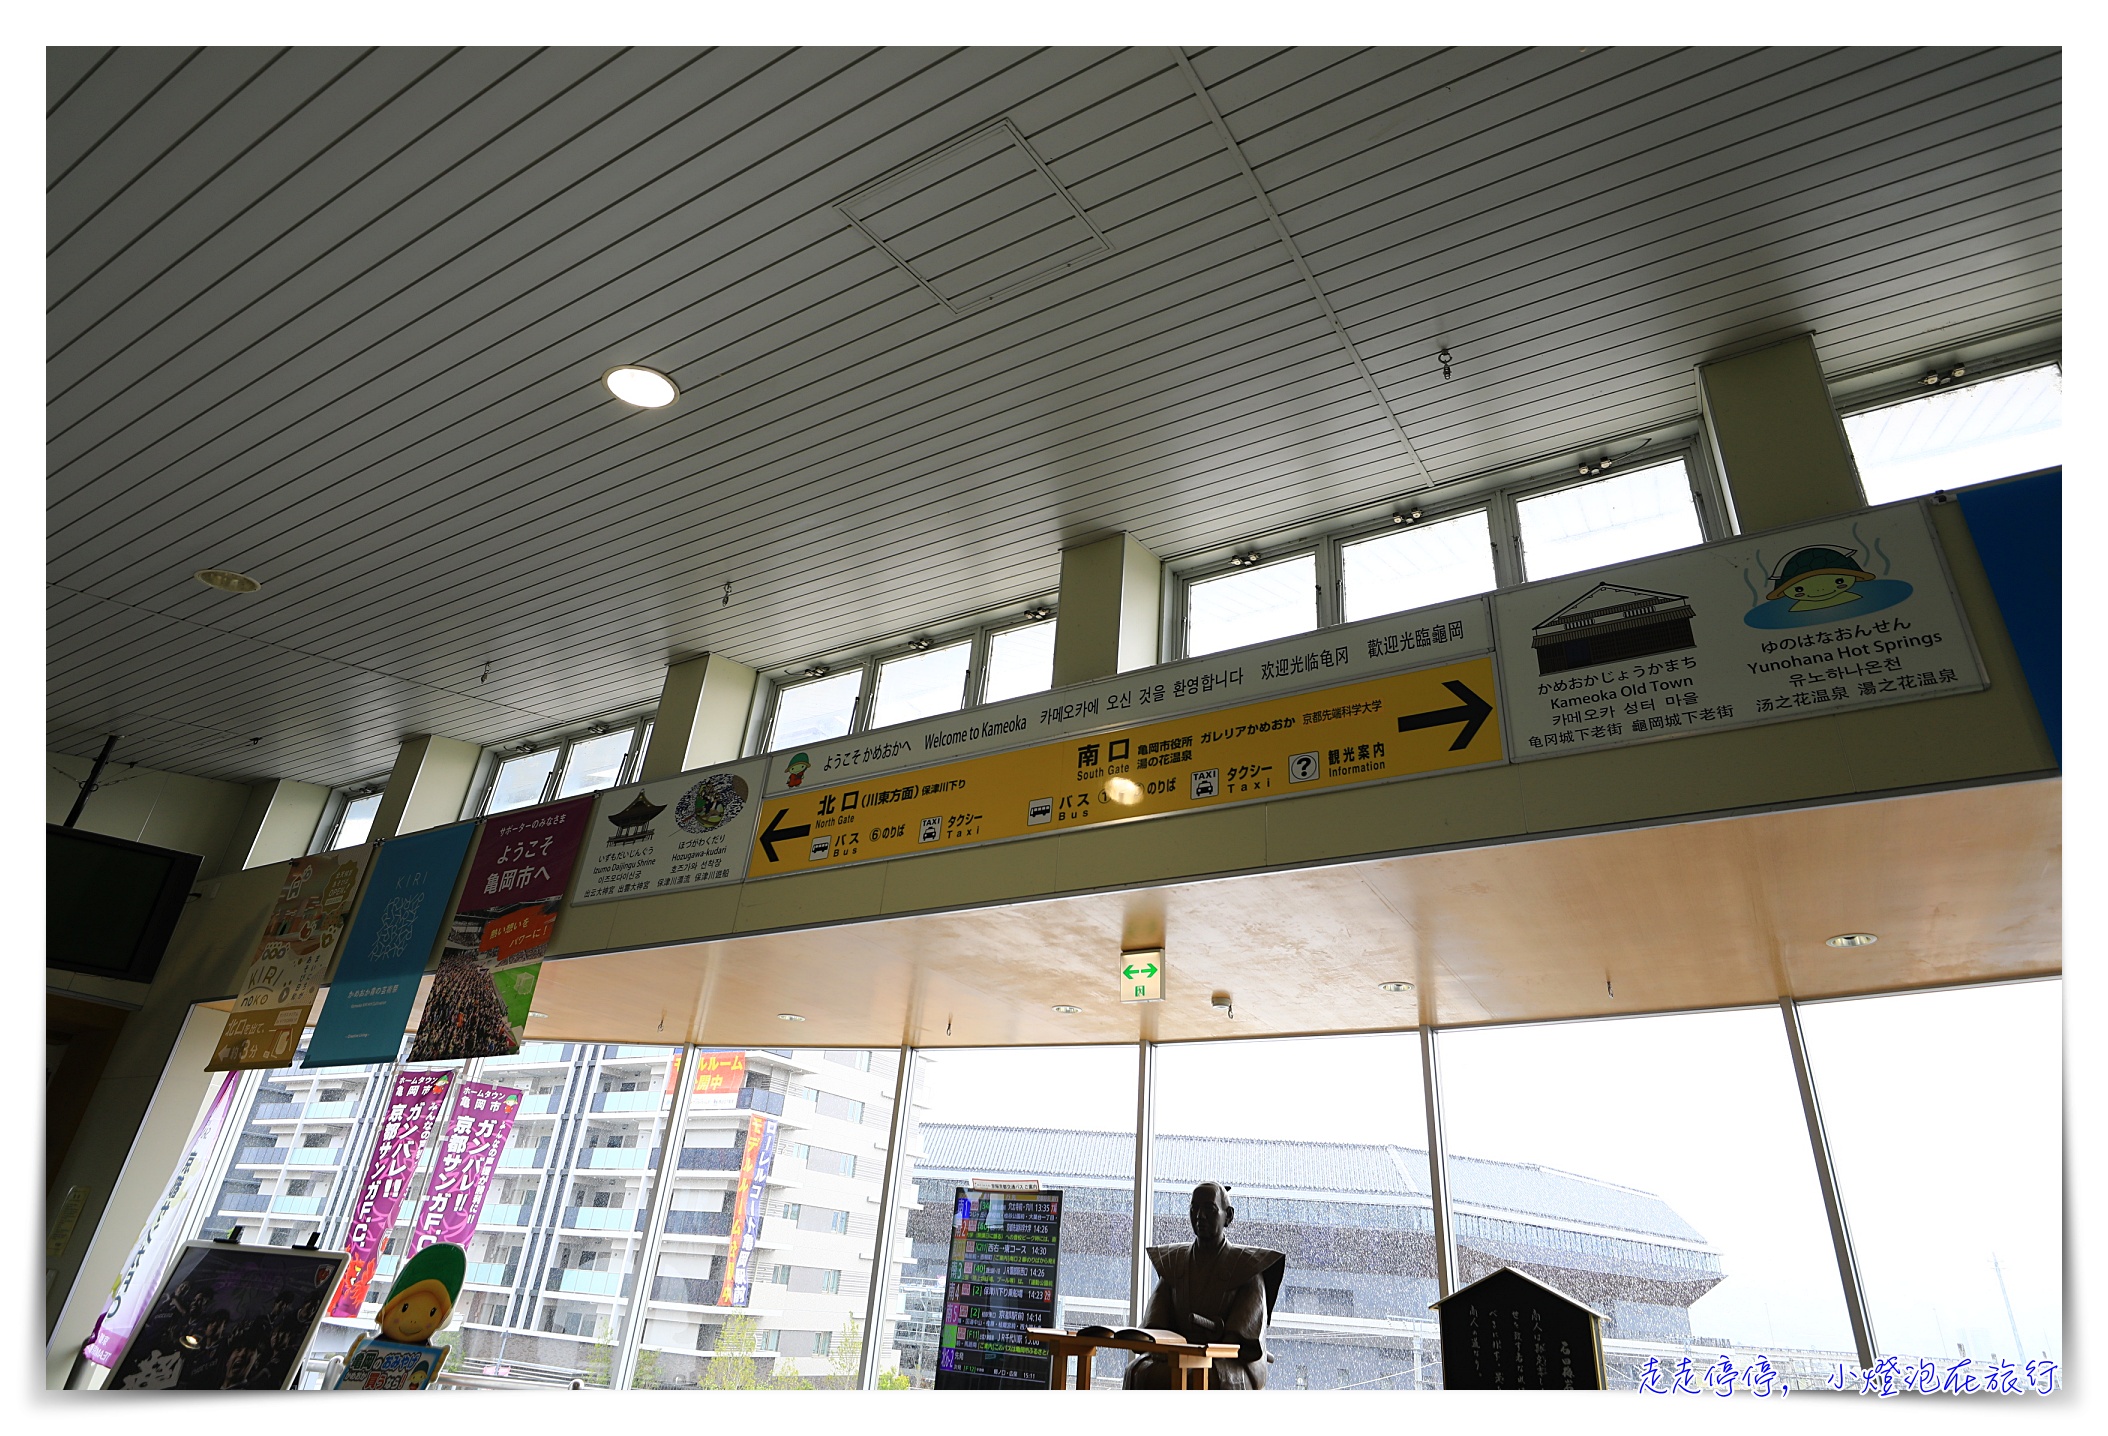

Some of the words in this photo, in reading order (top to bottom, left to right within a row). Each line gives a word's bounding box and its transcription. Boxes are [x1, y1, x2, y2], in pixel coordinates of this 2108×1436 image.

[1367, 620, 1464, 659] 歡迎光臨龜岡
[1761, 617, 1912, 654] ゆのはなおんせん
[1747, 653, 1833, 675] Yunohana
[1838, 642, 1870, 660] Hot
[1873, 631, 1943, 655] Springs
[1538, 656, 1697, 696] かめおかじょうかまち
[1788, 656, 1903, 687] 유노하나온천
[1040, 698, 1099, 725] 카메오카에
[1106, 691, 1131, 710] 오신
[1139, 684, 1166, 705] 것을
[1173, 667, 1243, 698] 환영합니다
[1550, 690, 1617, 710] Kameoka
[1620, 682, 1647, 697] Old
[1650, 676, 1693, 692] Town
[1756, 687, 1850, 713] 汤之花温泉
[1302, 699, 1382, 726] 京都先端科学大学
[1552, 705, 1616, 727] 카메오카
[1623, 698, 1656, 716] 성터
[1665, 691, 1699, 708] 마을
[1631, 704, 1734, 734] 龜岡城下老街
[925, 729, 967, 750] Welcome
[969, 727, 979, 741] to
[981, 715, 1027, 738] Kameoka
[1201, 716, 1296, 744] ガレリアかめおか
[1078, 738, 1130, 768] 南口
[1138, 735, 1193, 756] 亀岡市役所
[1328, 741, 1385, 767] 観光案内
[1137, 750, 1192, 770] 湯の花温泉
[1328, 761, 1386, 777] Information
[1077, 768, 1103, 781] South
[1108, 763, 1129, 776] Gate
[1193, 771, 1216, 780] TAXI
[1227, 764, 1273, 782] タクシー
[922, 779, 966, 797] 保津川下り
[1058, 792, 1090, 810] バス
[500, 814, 567, 836] サポーターのみなさま
[815, 816, 835, 829] North
[838, 814, 855, 825] Gate
[922, 817, 940, 827] TAXI
[947, 813, 983, 828] タクシー
[1058, 809, 1089, 822] Bus
[678, 835, 726, 850] ほづがわくだり
[835, 832, 859, 847] バス
[497, 836, 554, 864] ようこそ
[598, 847, 654, 864] いずもだいじんぐう
[672, 846, 727, 861] Hozugawa-kudari
[637, 858, 656, 869] Shrine
[484, 865, 550, 895] 亀岡市へ
[250, 965, 285, 988] KIRI
[399, 1076, 438, 1085] ホームタウン
[395, 1085, 432, 1098] 亀岡市
[463, 1088, 505, 1100] ホームタウン
[460, 1096, 501, 1112] 亀岡市
[1035, 1202, 1050, 1213] 13:35
[1033, 1223, 1048, 1234] 14:26
[350, 1350, 422, 1371] 亀岡のおみやげ
